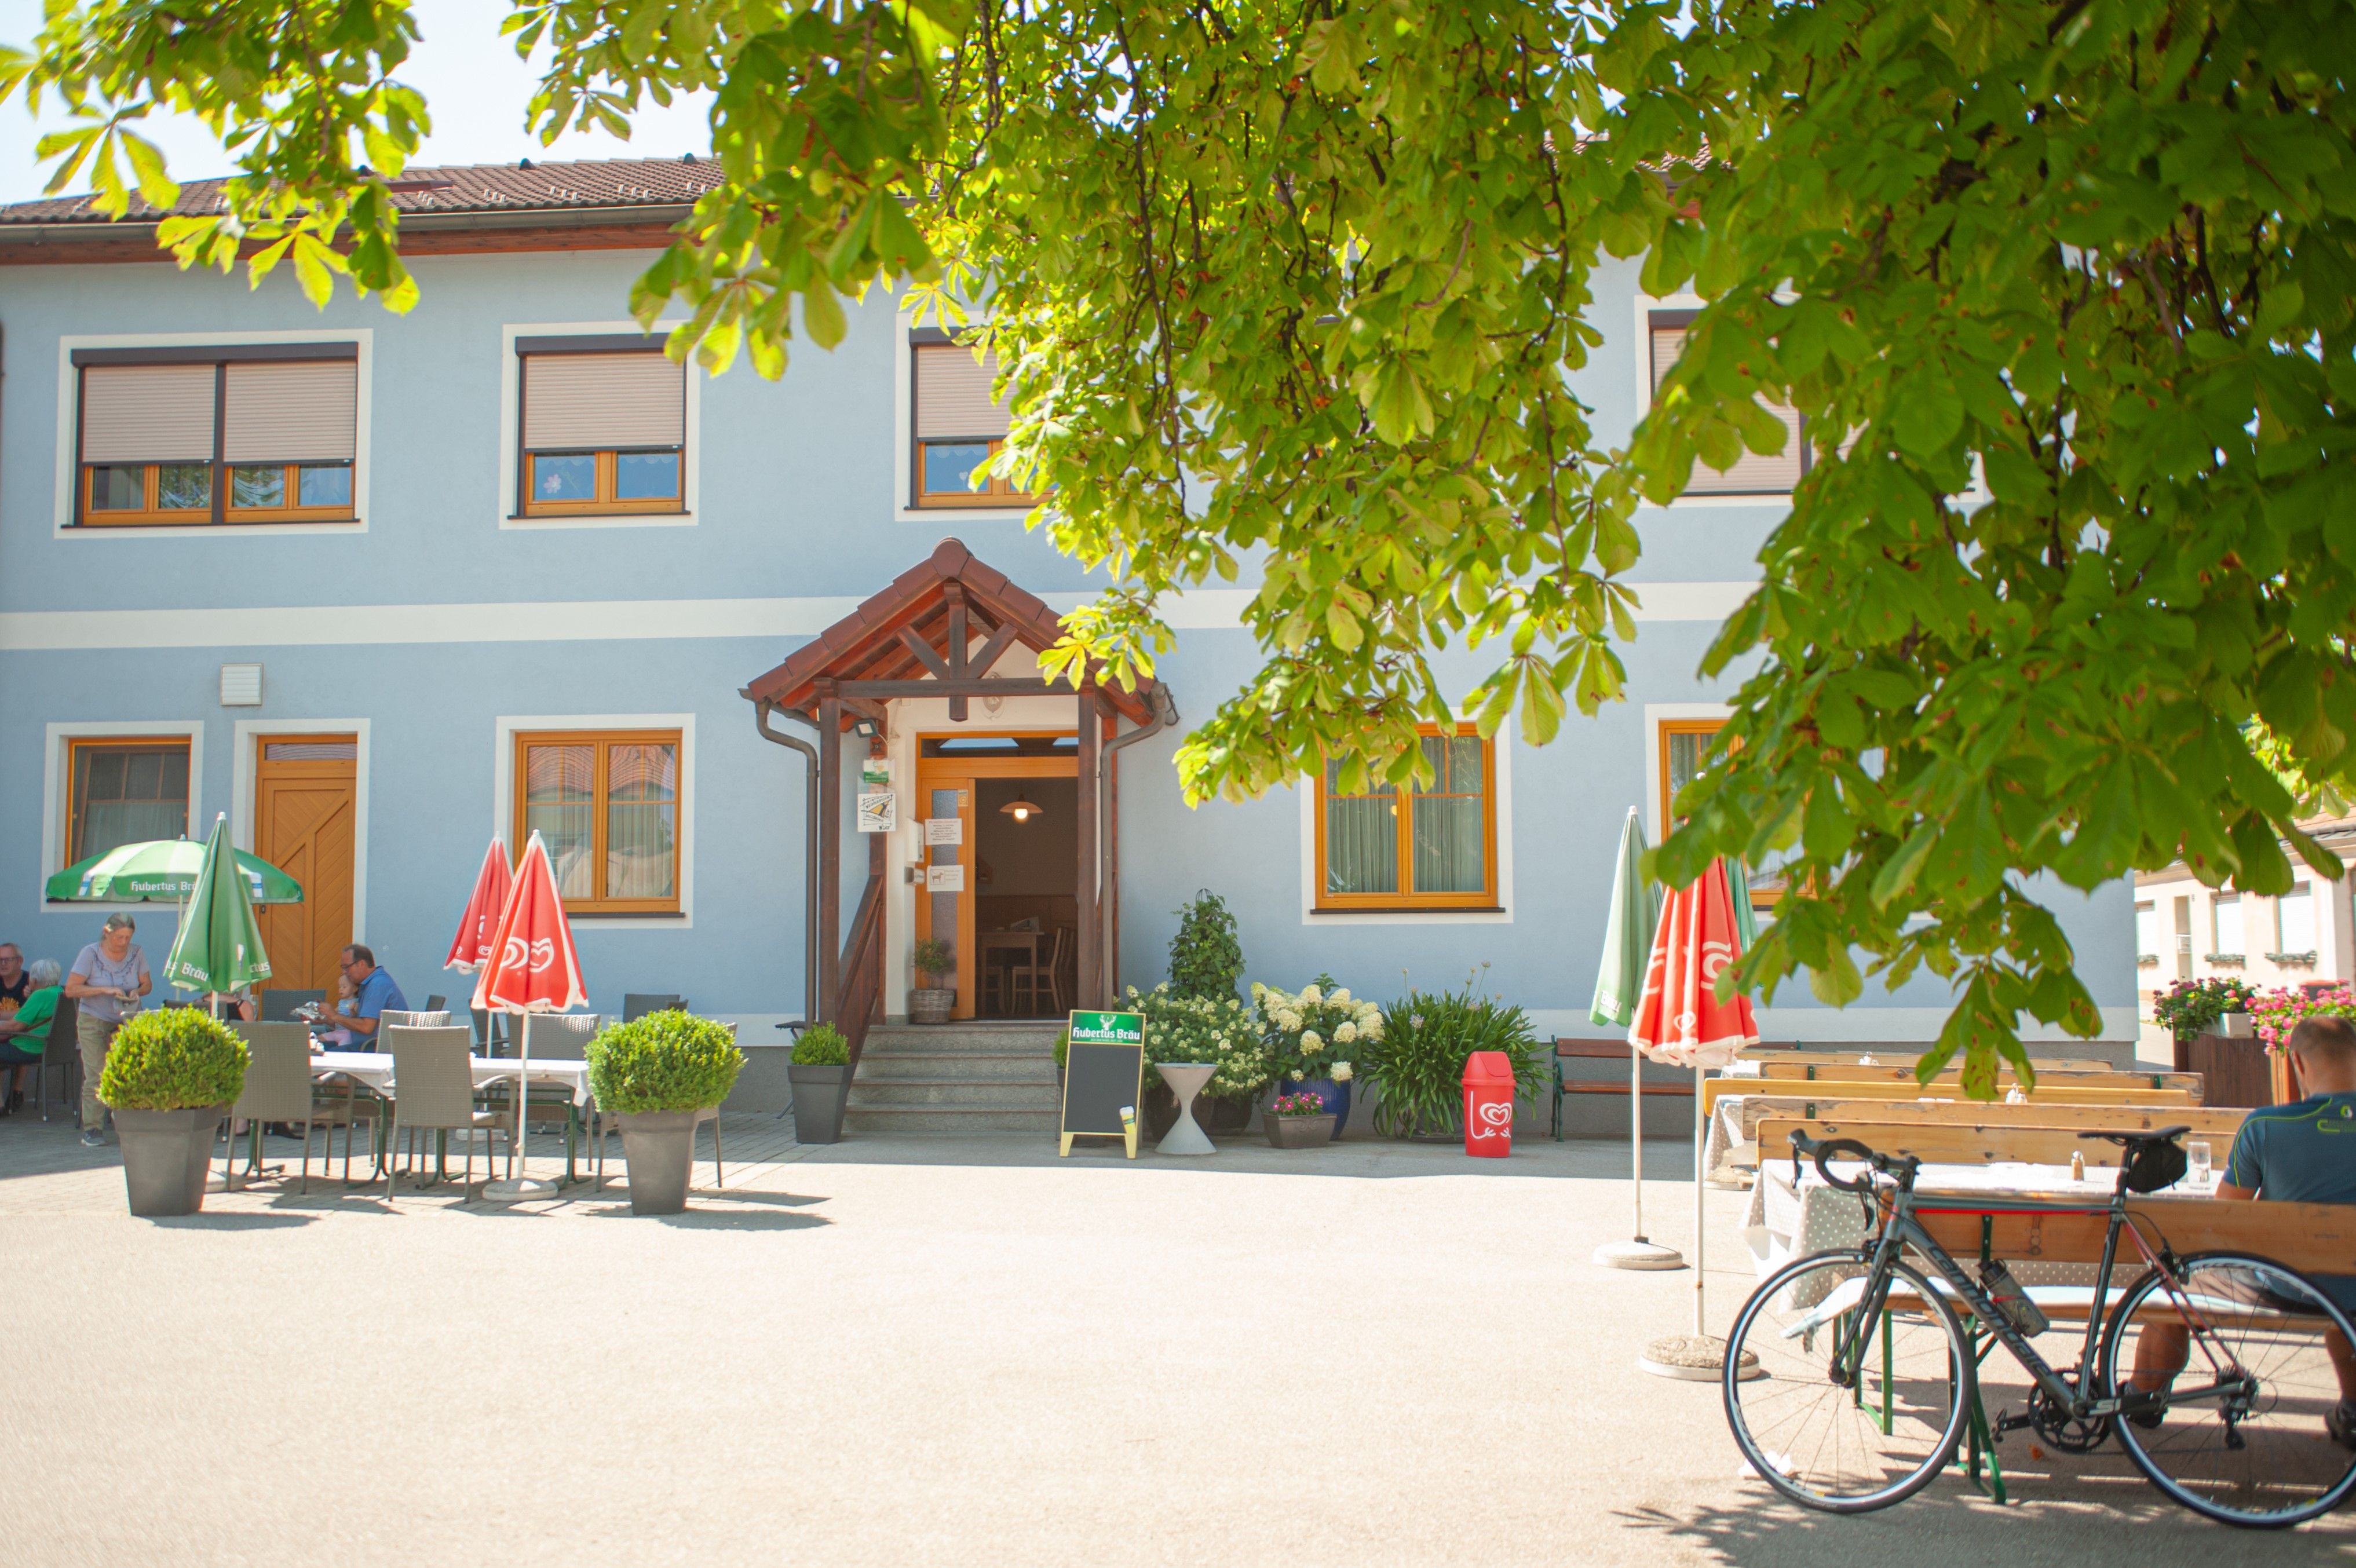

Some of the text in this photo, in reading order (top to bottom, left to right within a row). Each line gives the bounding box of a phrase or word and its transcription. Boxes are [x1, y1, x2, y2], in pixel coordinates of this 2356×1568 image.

[131, 880, 176, 891] Hubertus
[181, 962, 209, 982] Bräu
[1072, 1026, 1141, 1040] Hubertus Bräu
[1927, 1247, 2052, 1376] cannondale
